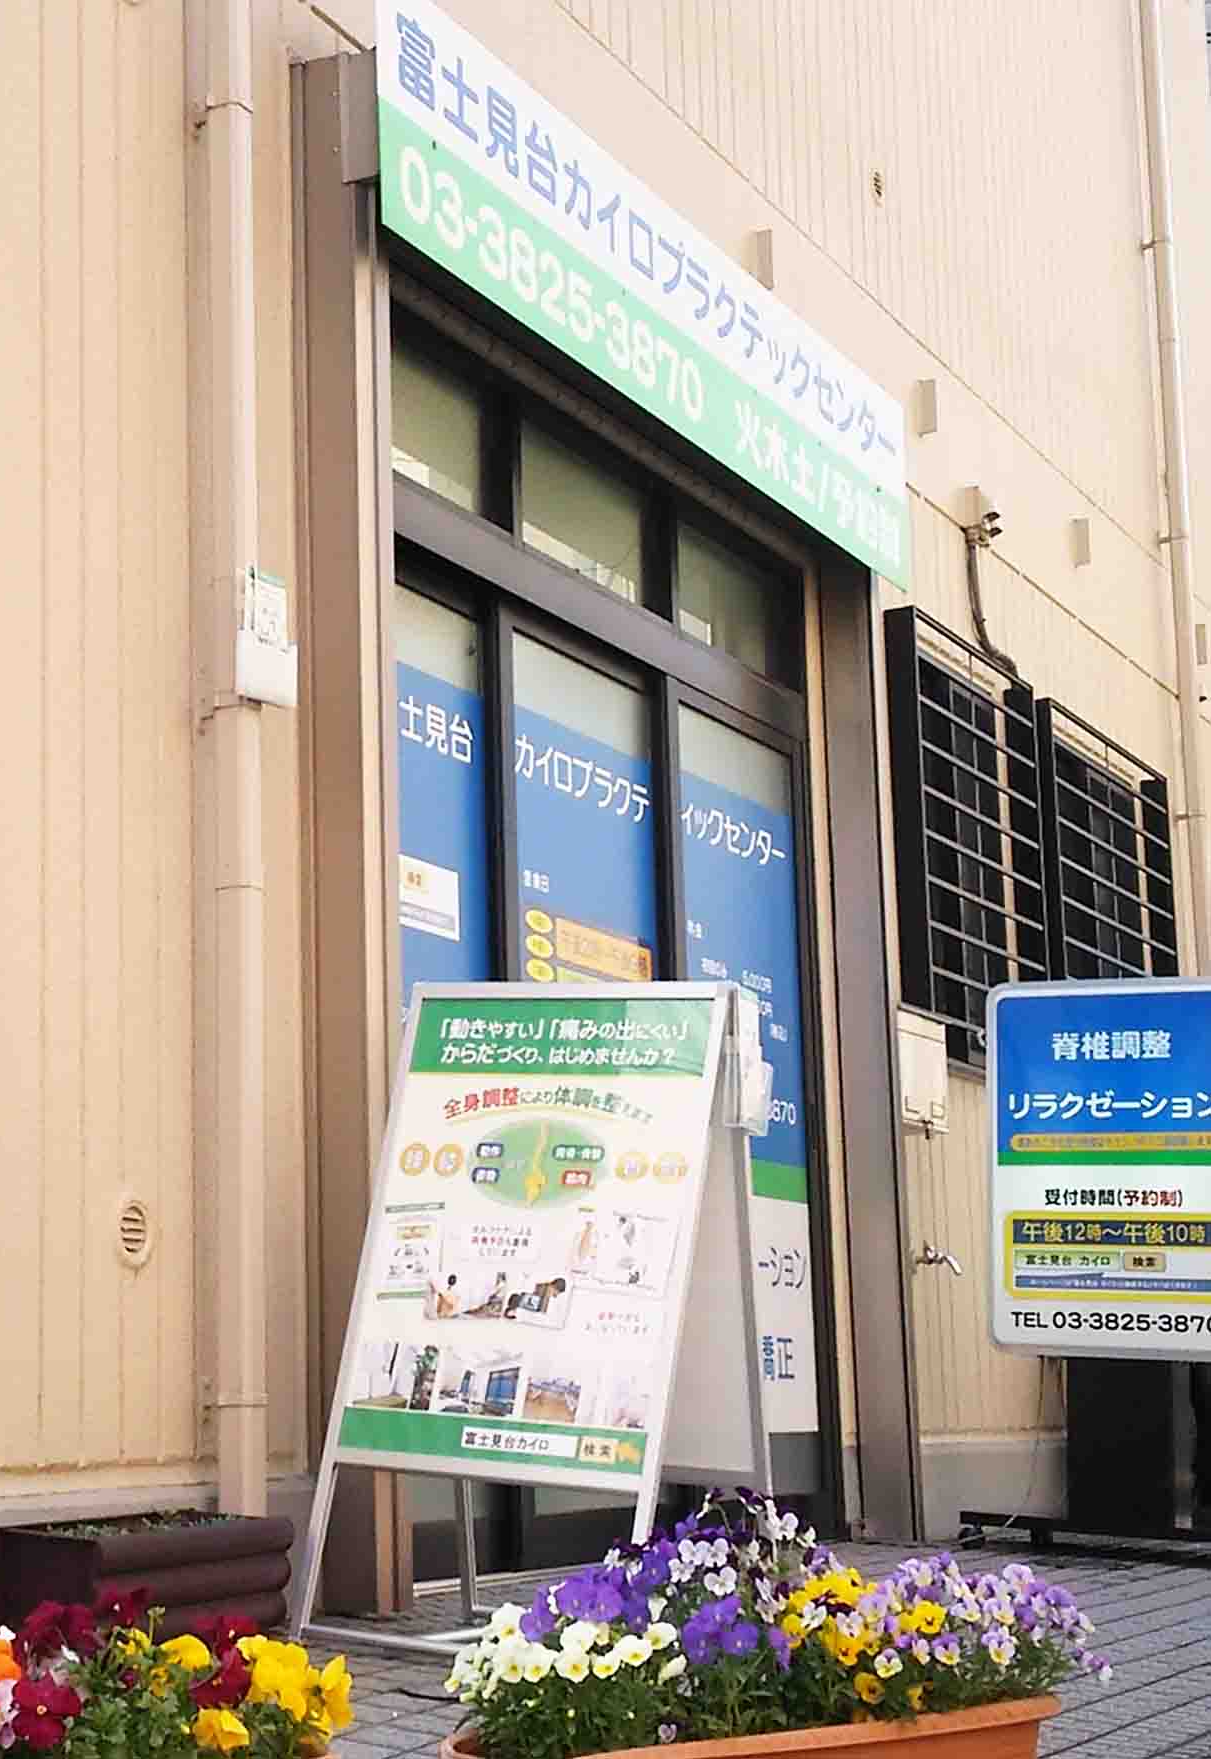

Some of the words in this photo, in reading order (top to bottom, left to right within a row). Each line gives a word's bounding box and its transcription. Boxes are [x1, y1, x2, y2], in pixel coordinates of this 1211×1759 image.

[398, 145, 704, 423] 03-3825-3870
[1052, 1031, 1172, 1061] 脊椎調整
[1009, 1089, 1211, 1120] リラクゼーション
[1045, 1188, 1183, 1207] 受付時間(予約制)
[1022, 1221, 1206, 1244] 午後12時～午後10時
[1011, 1311, 1048, 1329] TEL
[465, 1431, 549, 1450] 富士見台カイロ
